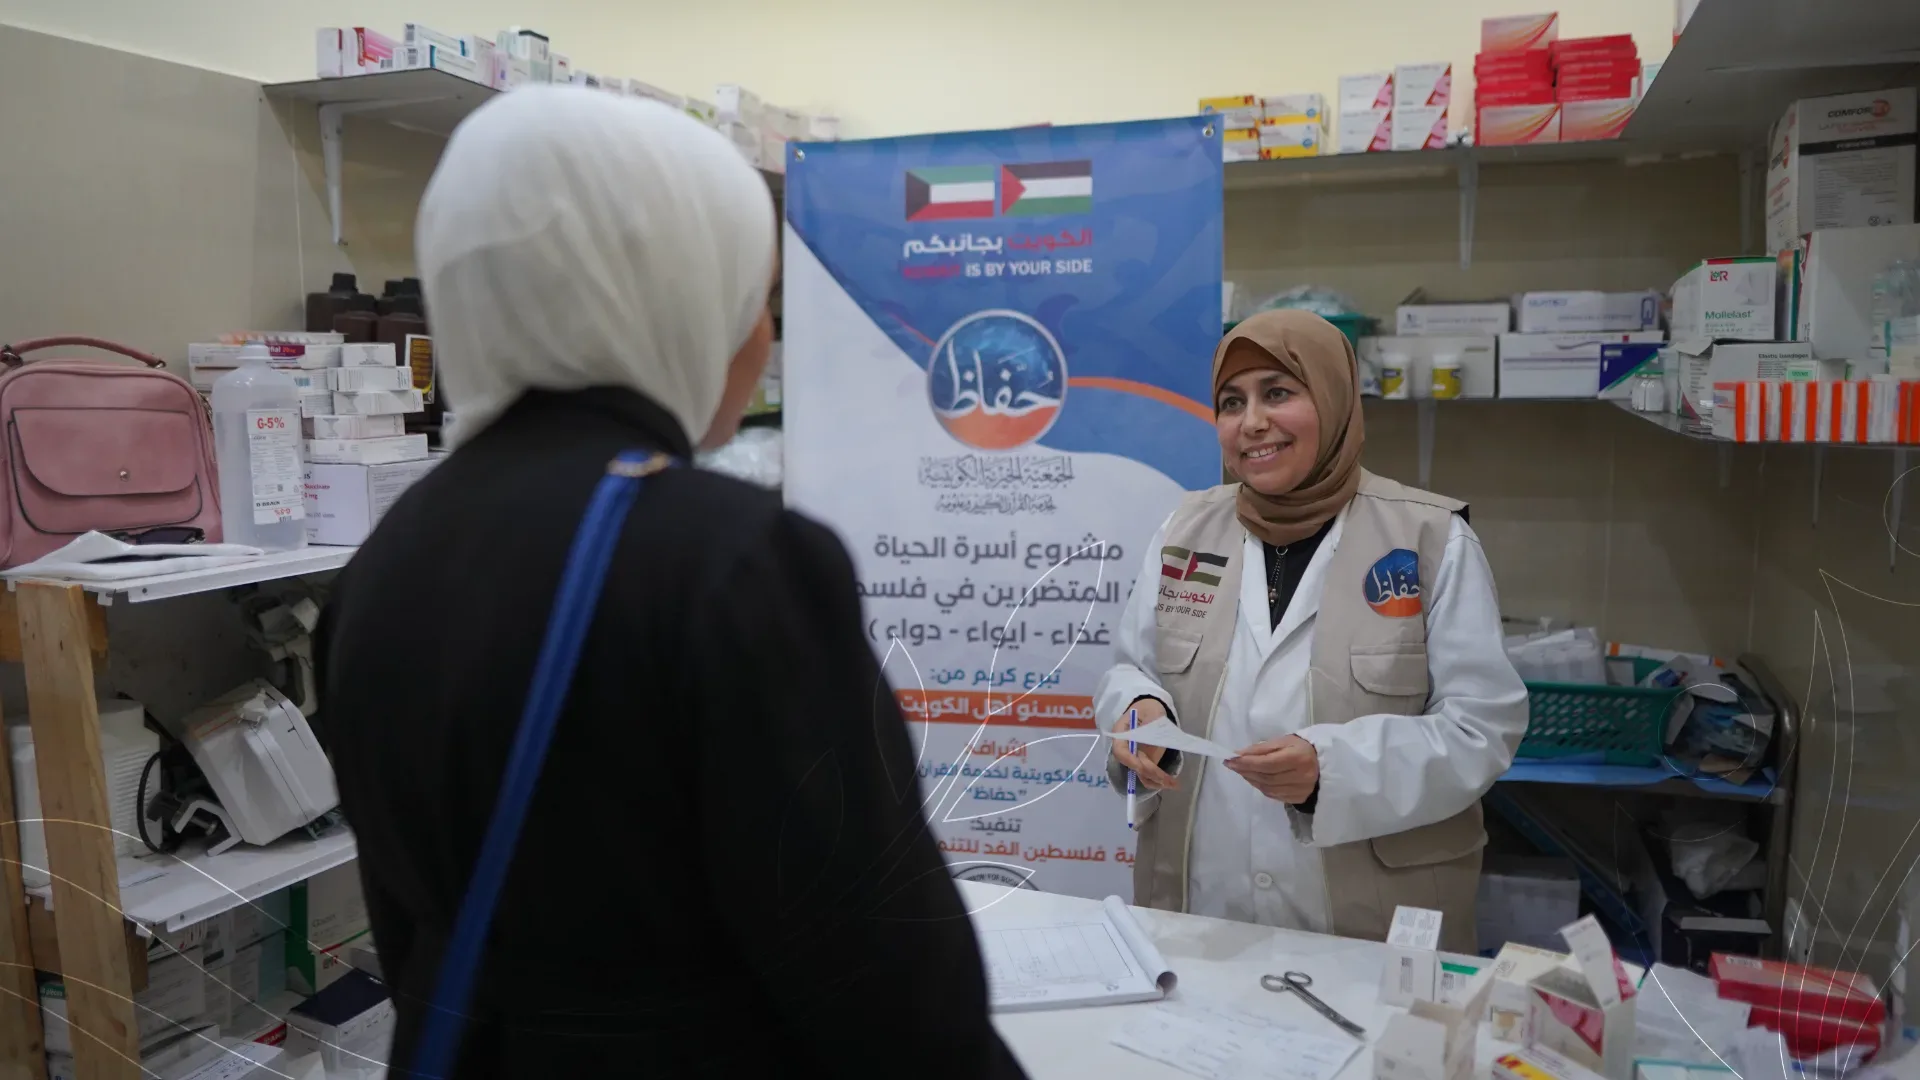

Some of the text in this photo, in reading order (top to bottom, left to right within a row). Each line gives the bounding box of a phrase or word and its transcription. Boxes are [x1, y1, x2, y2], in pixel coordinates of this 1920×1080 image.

[903, 228, 1092, 258] الكويت بجانبكم
[965, 262, 981, 277] IS
[985, 262, 1005, 277] BY
[1010, 260, 1051, 276] YOUR
[1056, 258, 1093, 274] SIDE
[257, 416, 285, 430] G-5%
[874, 530, 1124, 569] مشروع أسرة الحياة
[934, 578, 975, 614] في
[983, 578, 1119, 608] المتضررين
[1180, 590, 1215, 604] الكويت
[1191, 608, 1208, 618] SIDE
[886, 617, 942, 646] دواء
[1051, 621, 1111, 646] غذاء
[972, 667, 1016, 686] كريم
[1023, 668, 1062, 689] تبرع
[899, 694, 1095, 722] محسنو أهل الكويت
[962, 764, 1008, 780] لخدمة
[1012, 767, 1074, 786] الكويتية
[1024, 843, 1107, 864] فلسطين
